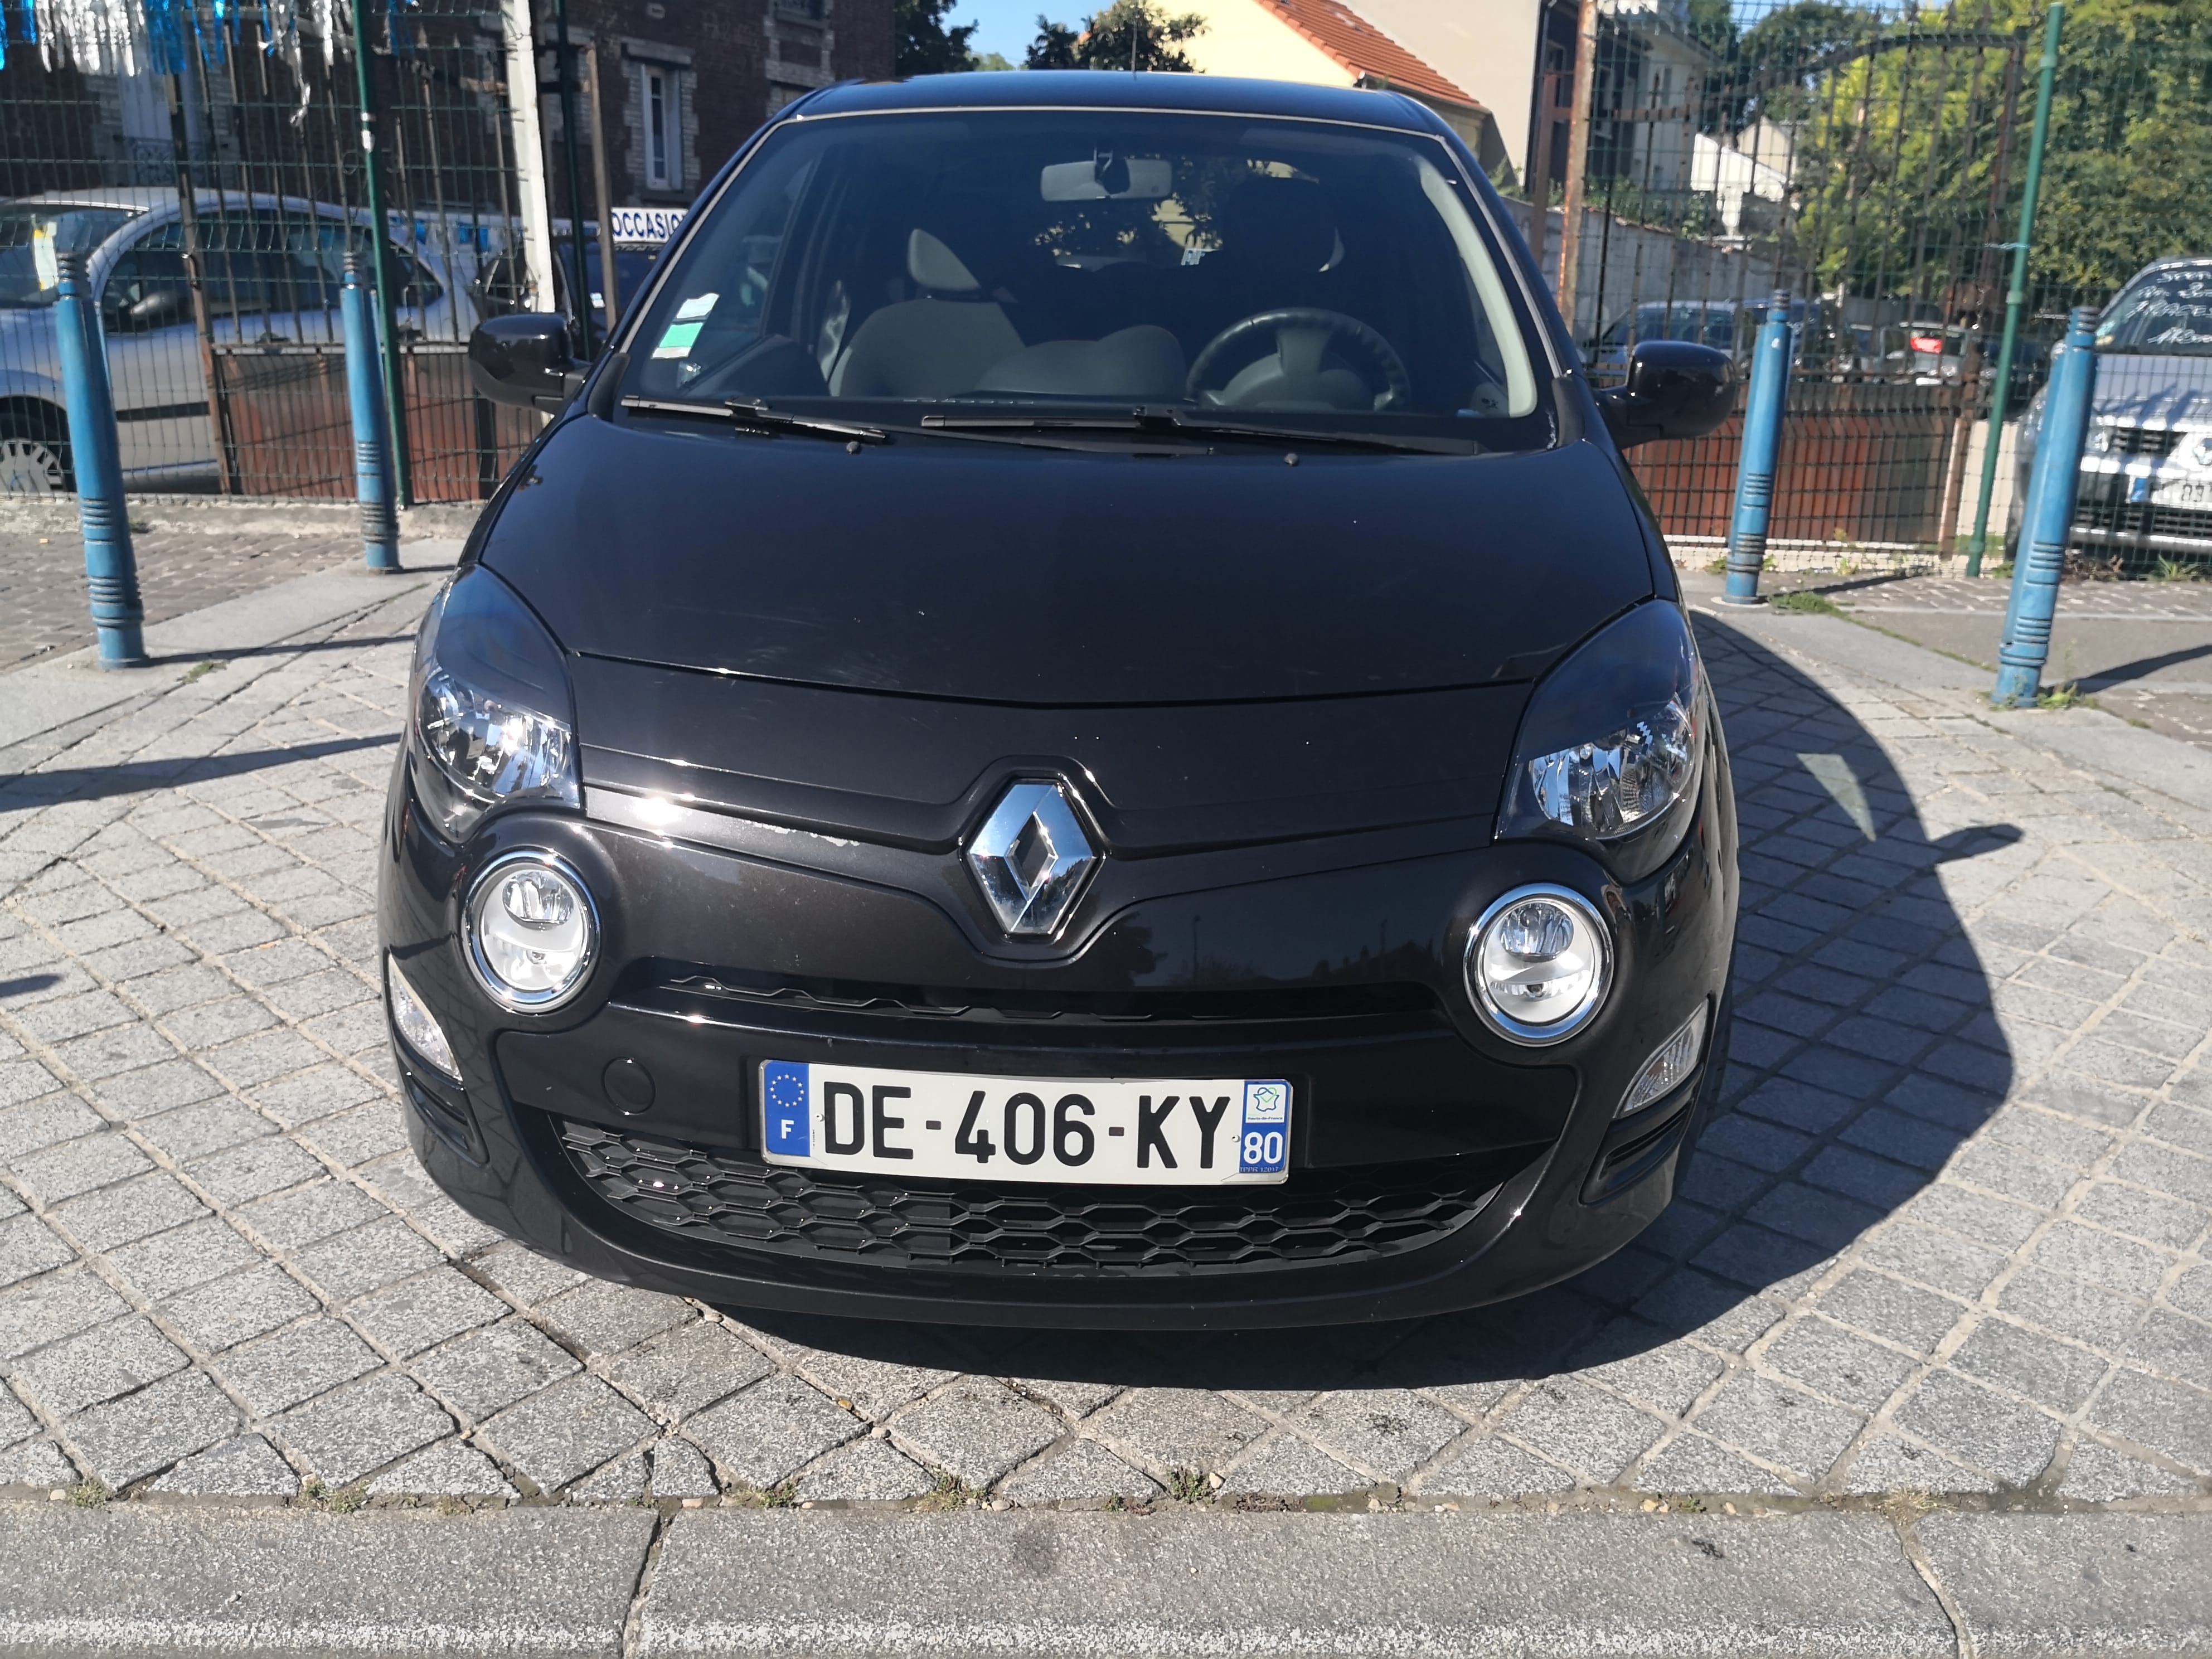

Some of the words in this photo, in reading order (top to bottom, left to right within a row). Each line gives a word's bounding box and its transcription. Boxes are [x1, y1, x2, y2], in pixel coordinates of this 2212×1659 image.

[612, 213, 685, 239] OCCASIO
[781, 1119, 794, 1139] F
[824, 1081, 1230, 1168] DE-406-KY
[1243, 1131, 1283, 1165] 80
